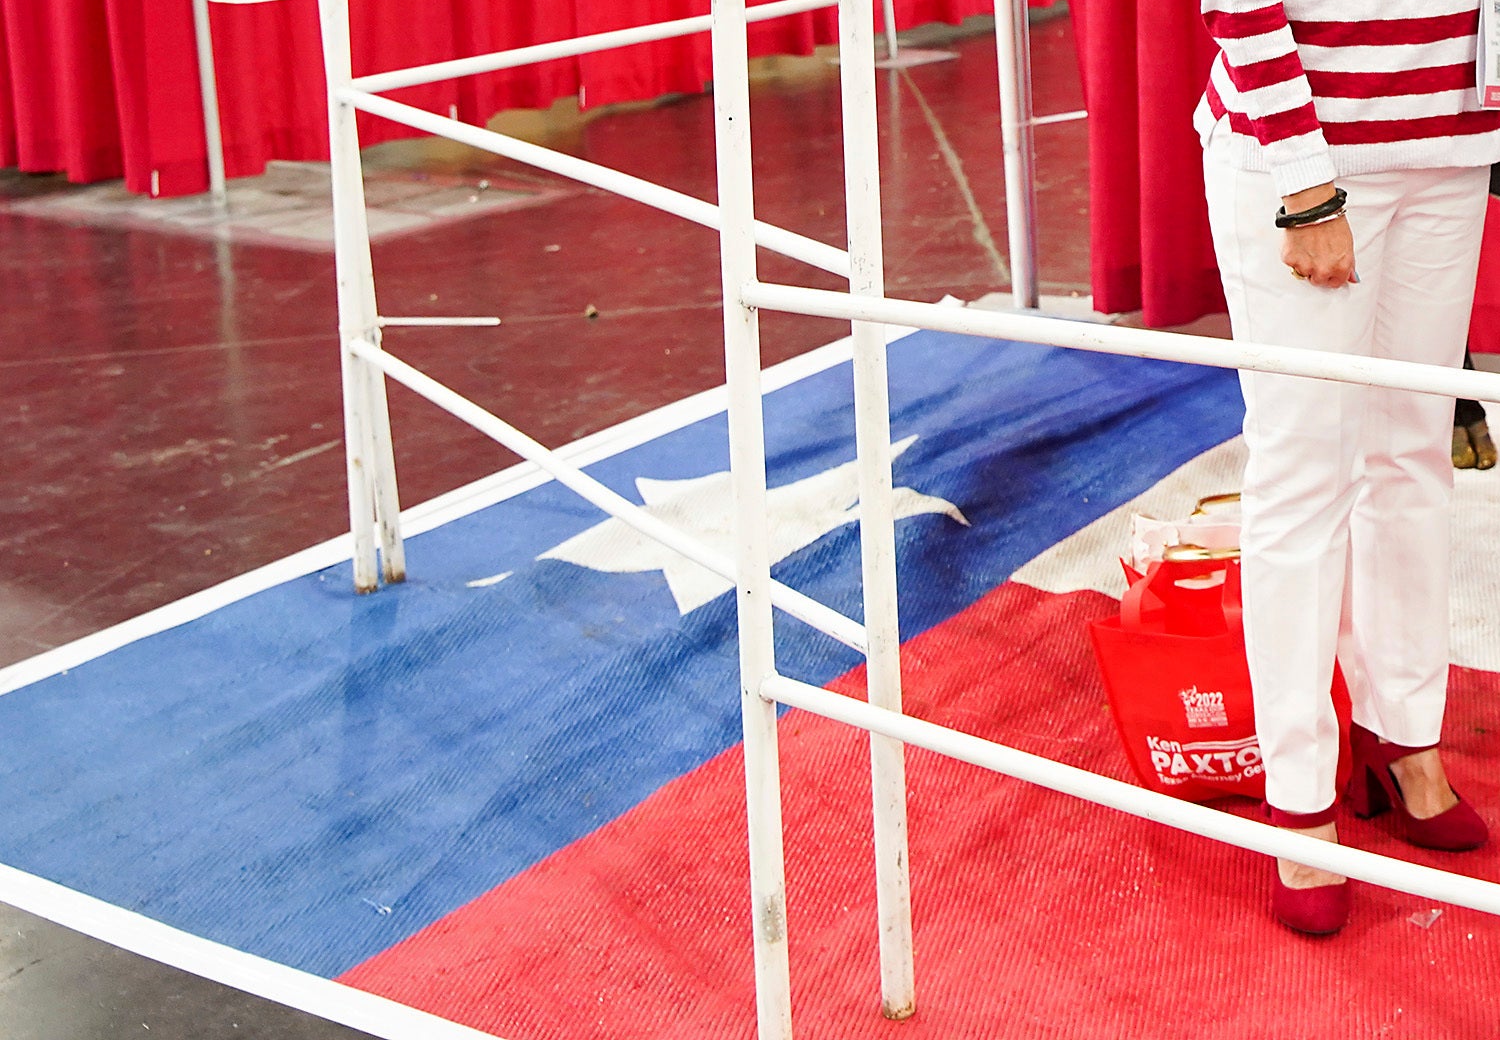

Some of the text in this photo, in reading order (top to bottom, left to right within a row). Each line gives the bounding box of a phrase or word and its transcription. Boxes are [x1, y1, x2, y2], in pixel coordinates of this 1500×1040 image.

[1195, 691, 1224, 708] 2022
[1146, 735, 1182, 753] Ken
[1150, 746, 1262, 776] PAXTO
